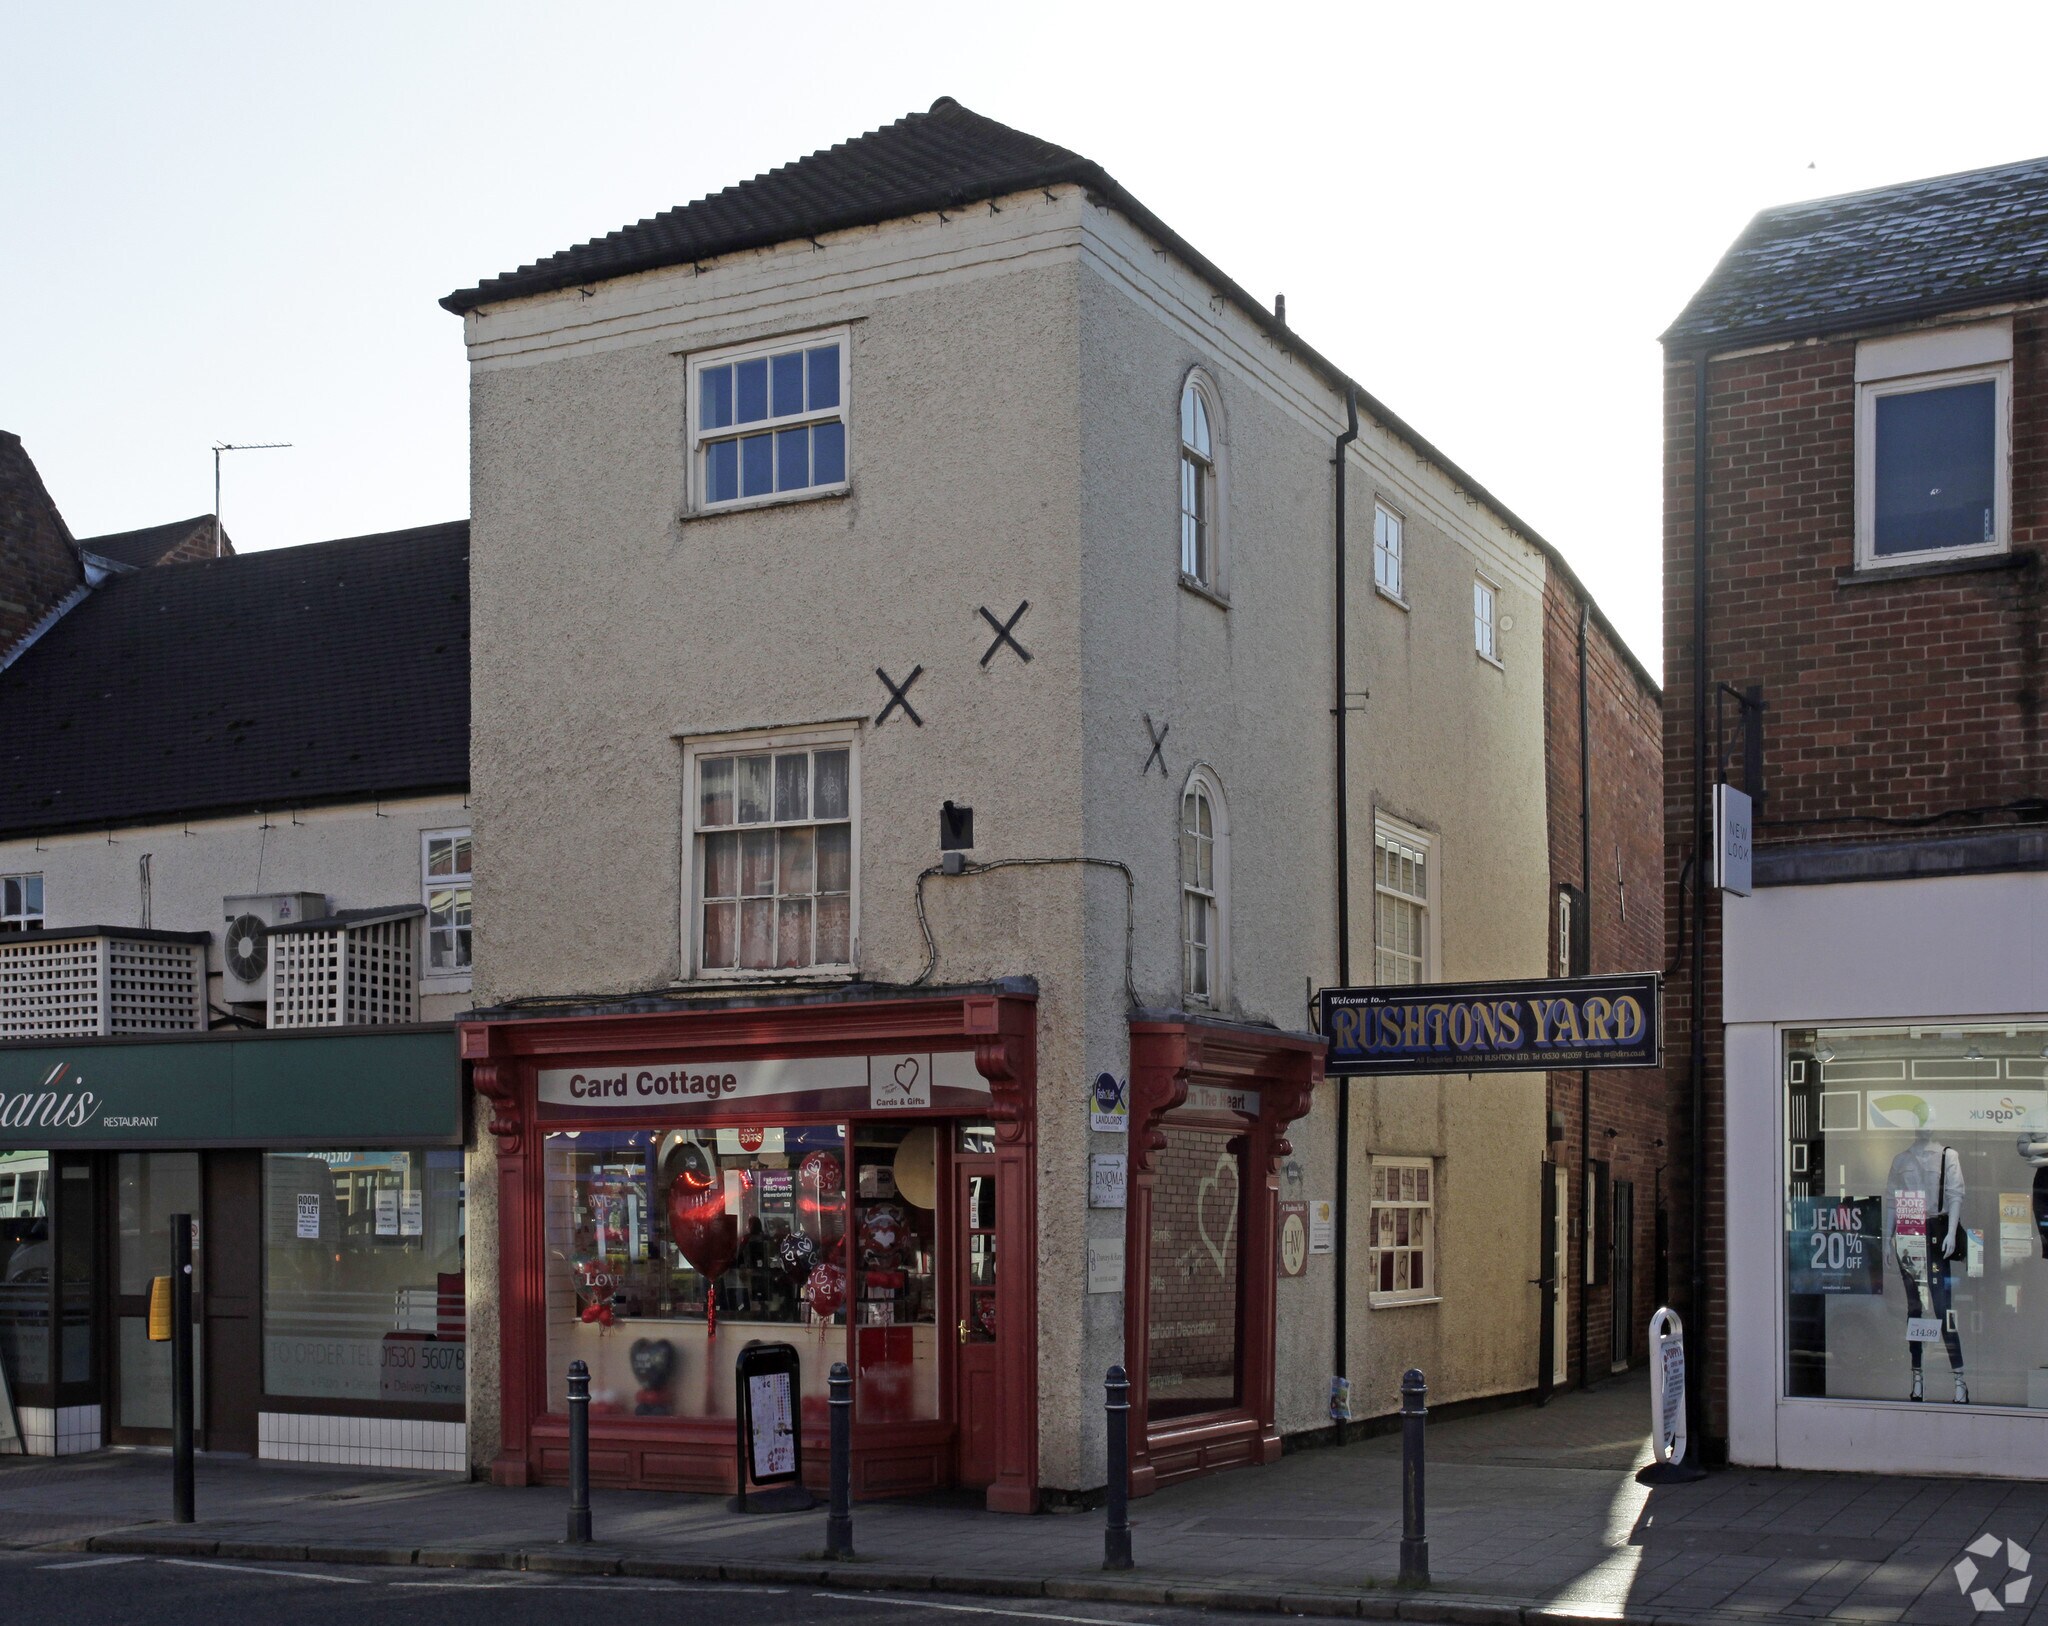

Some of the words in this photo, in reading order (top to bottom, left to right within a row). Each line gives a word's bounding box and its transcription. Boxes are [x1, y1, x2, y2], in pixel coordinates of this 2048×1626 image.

[1729, 821, 1747, 840] NEW
[1728, 842, 1748, 862] LOOK
[1330, 996, 1369, 1006] Welcome
[1332, 1001, 1522, 1051] RUSHTONS
[1528, 995, 1643, 1043] YARD
[1484, 1054, 1515, 1062] RUSHTON
[569, 1073, 628, 1098] Card
[636, 1071, 737, 1099] Cottage
[876, 1098, 898, 1106] Cards
[908, 1097, 925, 1105] Gifts
[1201, 1089, 1217, 1107] The
[1220, 1092, 1245, 1109] Heart
[103, 1117, 158, 1127] RESTAURANT
[1095, 1114, 1123, 1125] LANDLORDS
[298, 1195, 319, 1206] ROOM
[299, 1205, 307, 1214] TO
[308, 1205, 318, 1214] LET
[1811, 1208, 1862, 1231] JEANS
[1810, 1232, 1862, 1269] 20%
[1846, 1257, 1862, 1269] OFF
[585, 1272, 623, 1287] LOVE
[1176, 1321, 1216, 1336] Decoration
[295, 1343, 345, 1366] ORDER
[349, 1345, 374, 1367] TEL
[393, 1381, 428, 1395] Delivery
[430, 1382, 462, 1393] Service
